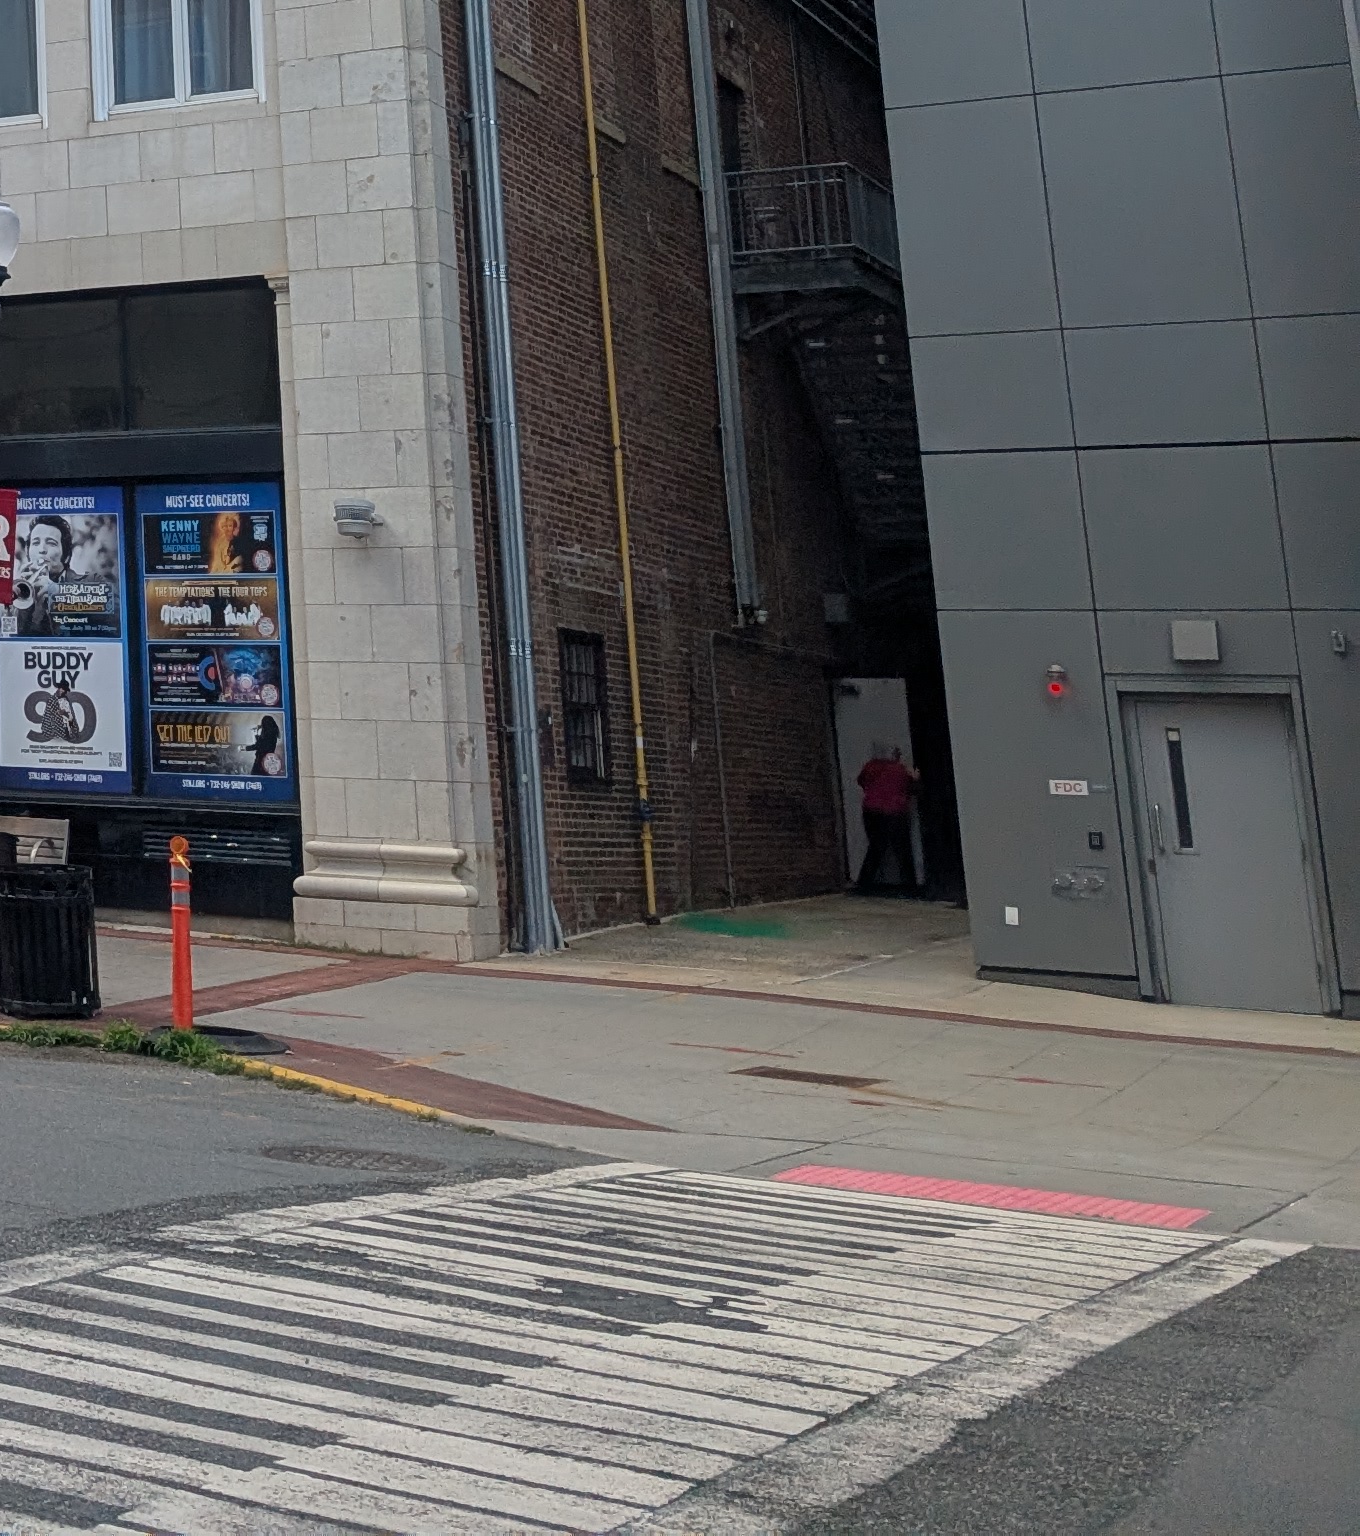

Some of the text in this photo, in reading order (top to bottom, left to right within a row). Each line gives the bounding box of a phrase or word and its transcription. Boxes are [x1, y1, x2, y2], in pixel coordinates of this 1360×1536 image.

[16, 496, 94, 510] MUST-SEE CONCERTS!
[166, 493, 250, 508] MUST-SEE CONCERTS!
[161, 520, 199, 532] KENNY
[161, 532, 201, 544] WAYNE
[155, 586, 215, 598] THE TEMPTATIONS
[218, 586, 268, 597] THE FOUR TOPS
[24, 651, 94, 671] BUDDY
[37, 670, 81, 689] GUY
[24, 690, 97, 744] 90
[156, 724, 231, 743] GET THE LED OUT
[1054, 782, 1082, 793] FDC
